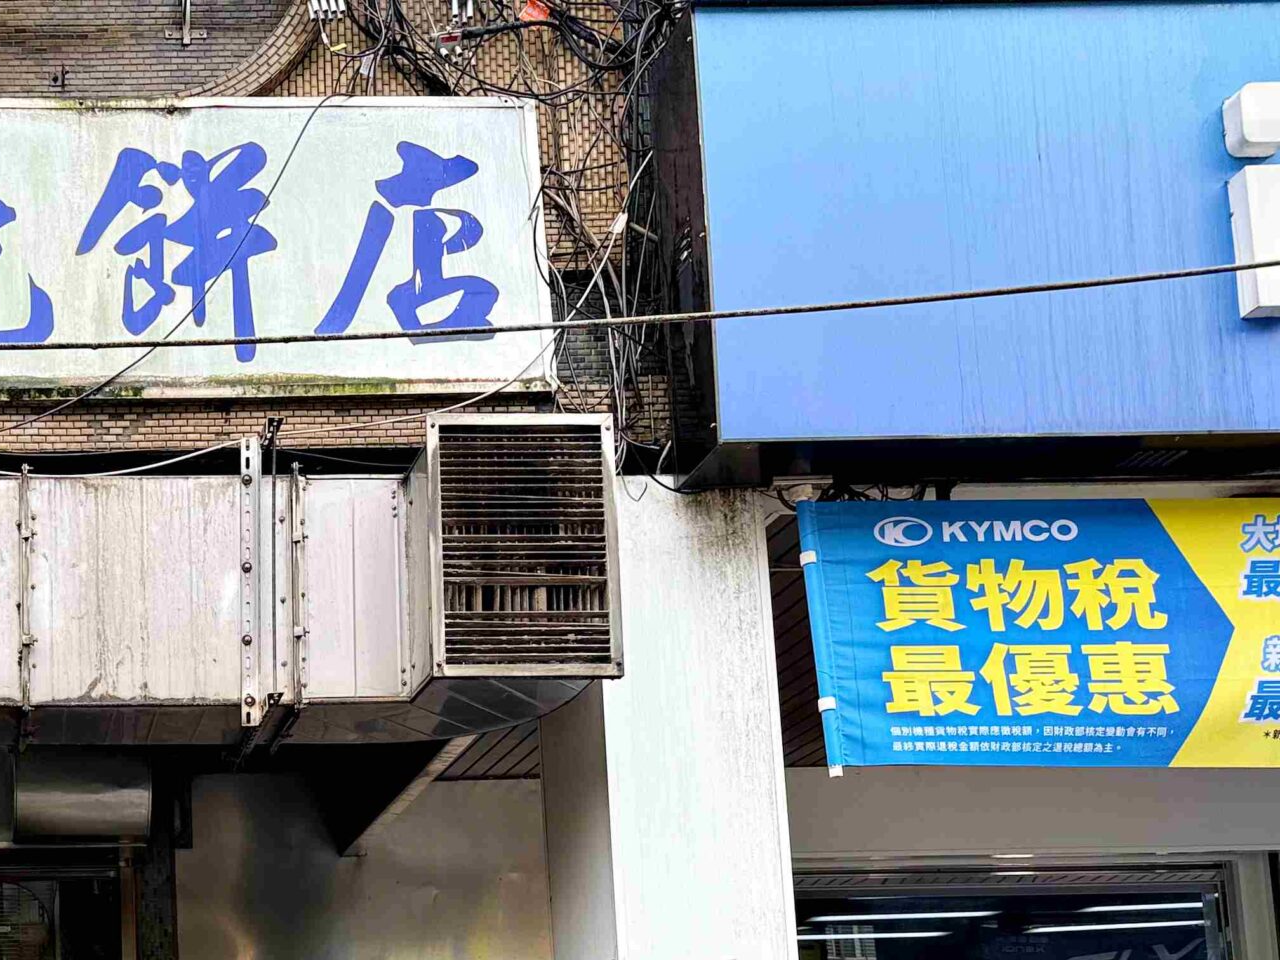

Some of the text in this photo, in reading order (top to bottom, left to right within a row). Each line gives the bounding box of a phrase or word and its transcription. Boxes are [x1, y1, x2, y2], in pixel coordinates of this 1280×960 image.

[942, 519, 1078, 543] KYMCO
[866, 558, 1168, 632] 貨物稅
[881, 641, 1180, 717] 最優惠
